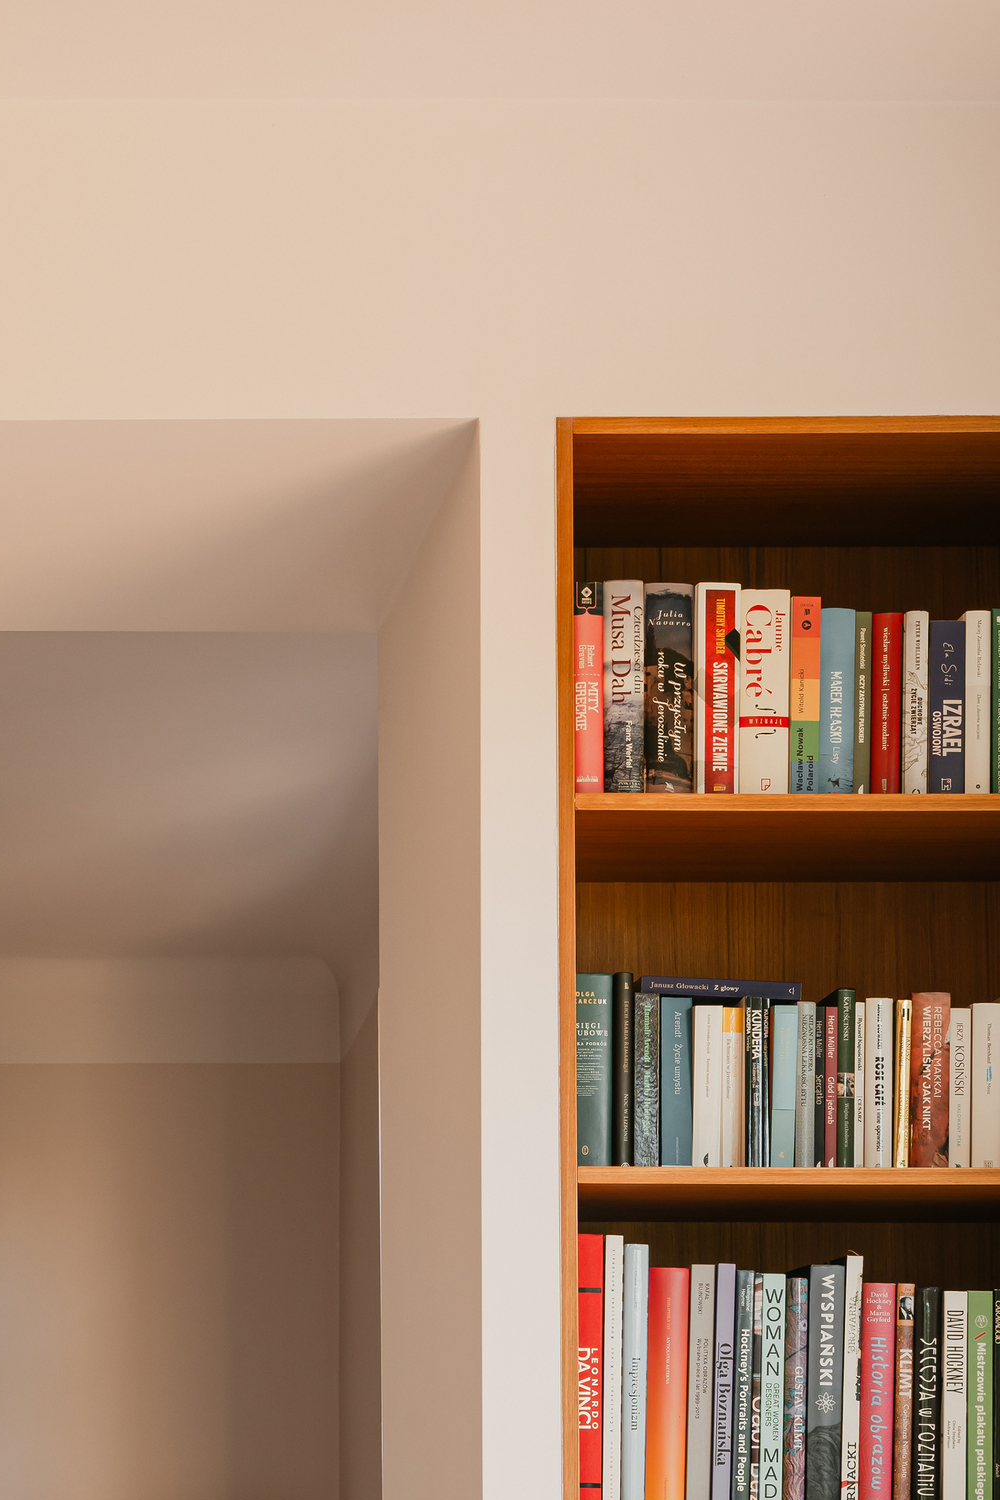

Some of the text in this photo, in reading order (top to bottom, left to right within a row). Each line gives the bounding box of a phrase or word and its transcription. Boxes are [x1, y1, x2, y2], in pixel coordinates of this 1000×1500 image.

[648, 618, 692, 627] Navarro
[656, 610, 684, 620] Julia
[715, 598, 725, 655] TIMOTHY SNYDER
[775, 610, 786, 652] Jaume
[579, 645, 588, 669] Graves
[588, 645, 596, 668] Robert
[611, 595, 632, 705] Musa Dah
[745, 604, 773, 698] Cabré
[941, 642, 957, 686] Ela Sidi
[575, 681, 587, 732] GRECKIE
[588, 681, 599, 714] MITY
[653, 650, 668, 764] roku w Jerozolimie
[669, 662, 688, 753] W przyszłym
[712, 661, 727, 772] SKRWAWIONE ZIEMIE
[830, 671, 843, 765] MAREK HŁASKO Listy
[932, 711, 942, 757] OSWOJONY
[942, 699, 963, 757] IZRAEL
[796, 728, 805, 791] Wacław Nowak
[806, 755, 814, 792] Polaroid
[650, 981, 676, 989] Janusz
[676, 982, 710, 991] Głowacki
[720, 985, 740, 993] głowy
[672, 1011, 685, 1095] Arendt Życie umysłu
[752, 1009, 762, 1060] KUNDERA
[816, 1038, 824, 1058] Müller
[828, 1015, 836, 1034] Herta
[828, 1035, 836, 1059] Müller
[934, 1006, 943, 1098] REBECCA MAKKAI
[815, 1074, 824, 1105] Sercątko
[828, 1076, 836, 1094] Głód
[922, 1006, 933, 1131] WIERZYLIŚMY JAK NIKT
[826, 1099, 836, 1125] jedwab
[765, 1289, 784, 1377] WOMAN
[819, 1273, 835, 1386] WYSPIAŃSKI
[946, 1310, 964, 1394] DAVID HOCKNEY
[579, 1347, 591, 1430] DA VINCI
[591, 1347, 599, 1430] LEONARDO
[630, 1356, 642, 1431] Impresjonizm
[702, 1366, 710, 1394] OBRAZÓW
[976, 1342, 987, 1402] Mistrzowie
[715, 1342, 733, 1467] Olga Boznańska
[765, 1382, 773, 1427] DESIGNERS
[794, 1366, 804, 1450] GUSTAV KLIMT
[870, 1336, 889, 1490] Historia obrazów
[975, 1405, 986, 1446] plakatu
